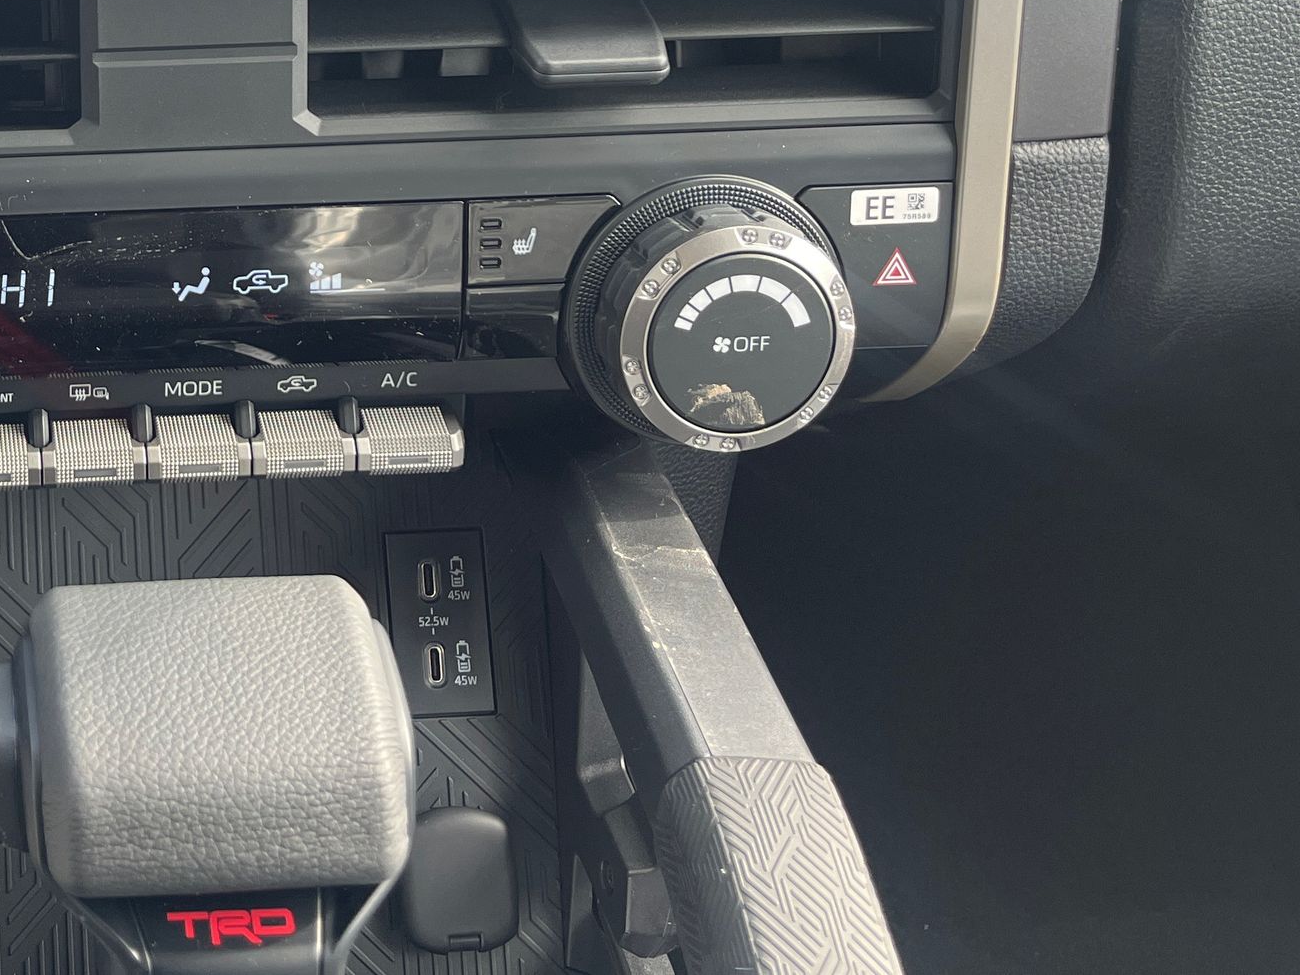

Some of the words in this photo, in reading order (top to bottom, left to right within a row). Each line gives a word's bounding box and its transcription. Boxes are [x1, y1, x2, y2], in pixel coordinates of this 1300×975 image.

[865, 195, 896, 221] EE
[733, 336, 771, 353] OFF
[164, 379, 223, 398] MODE
[381, 371, 418, 389] A/C
[447, 589, 471, 601] 45W
[418, 616, 450, 628] 52.5W
[454, 675, 478, 686] 45W
[166, 907, 297, 946] TRD
